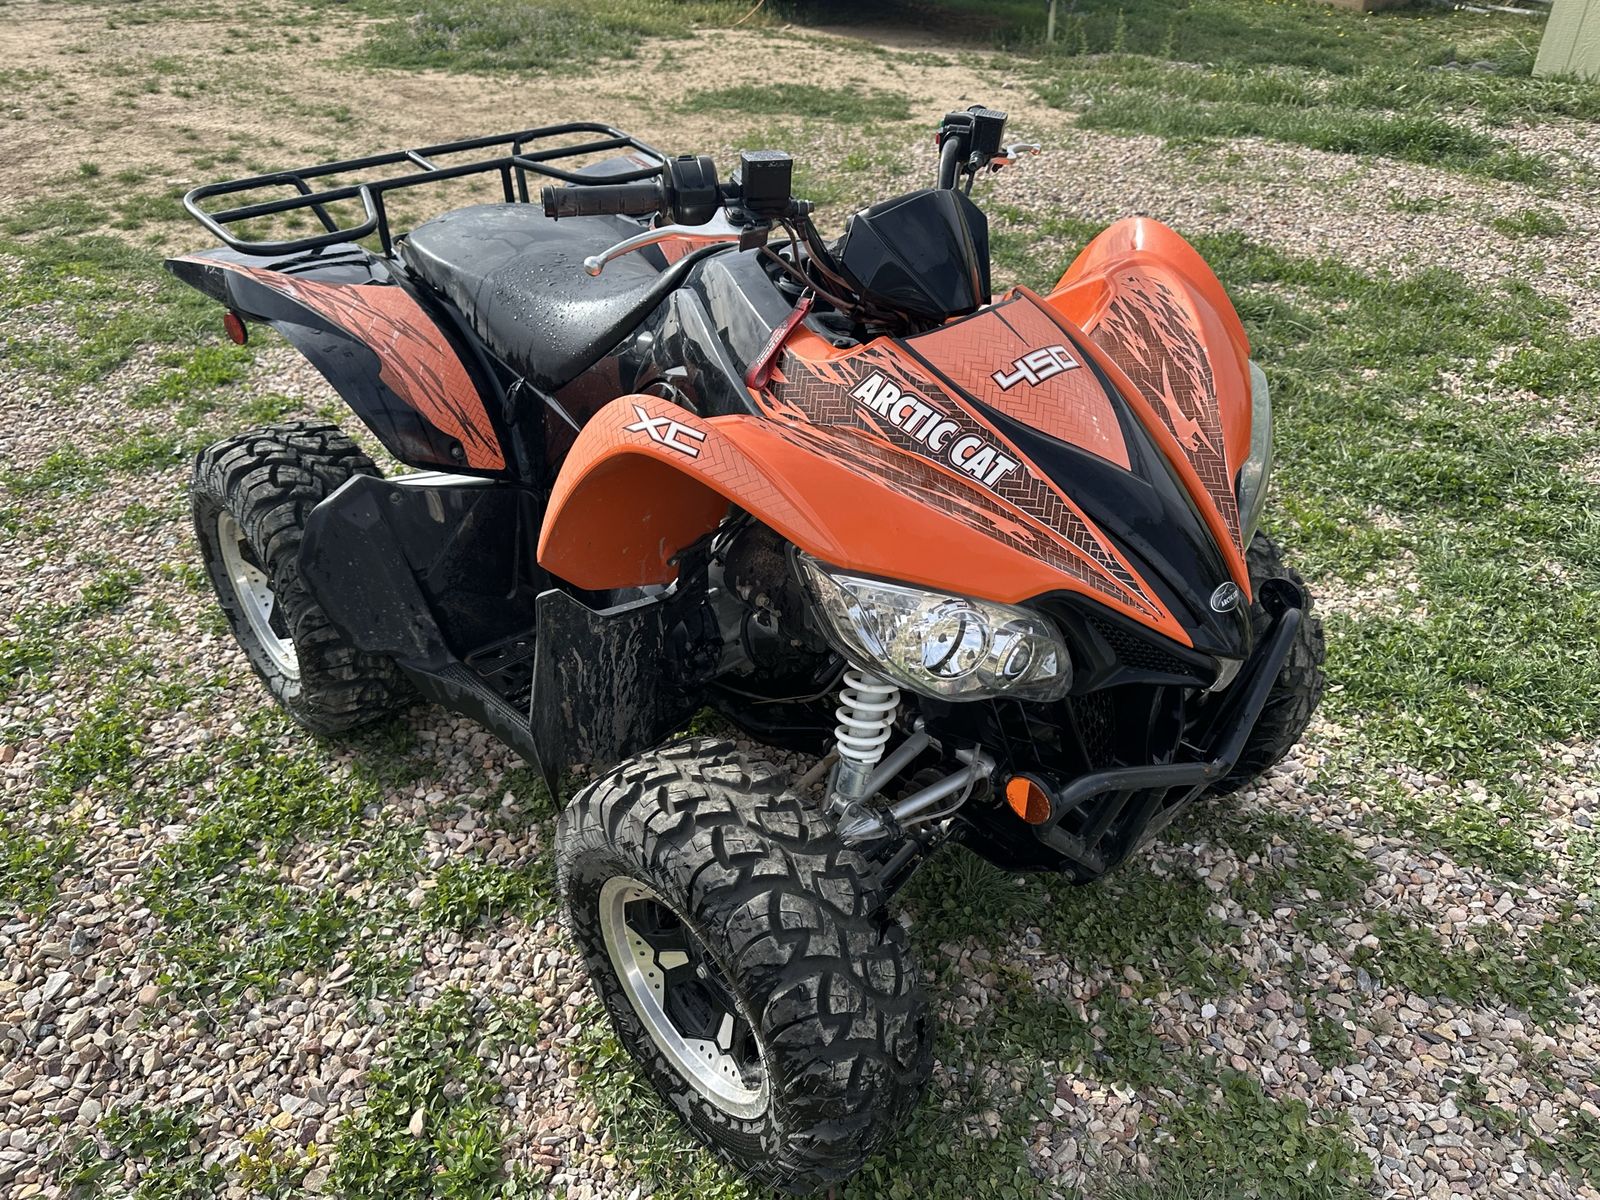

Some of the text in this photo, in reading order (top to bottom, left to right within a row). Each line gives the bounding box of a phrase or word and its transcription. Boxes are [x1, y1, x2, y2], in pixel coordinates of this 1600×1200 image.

[991, 345, 1081, 391] 450
[623, 404, 707, 458] XC
[851, 371, 1020, 487] ARCTIC CAT
